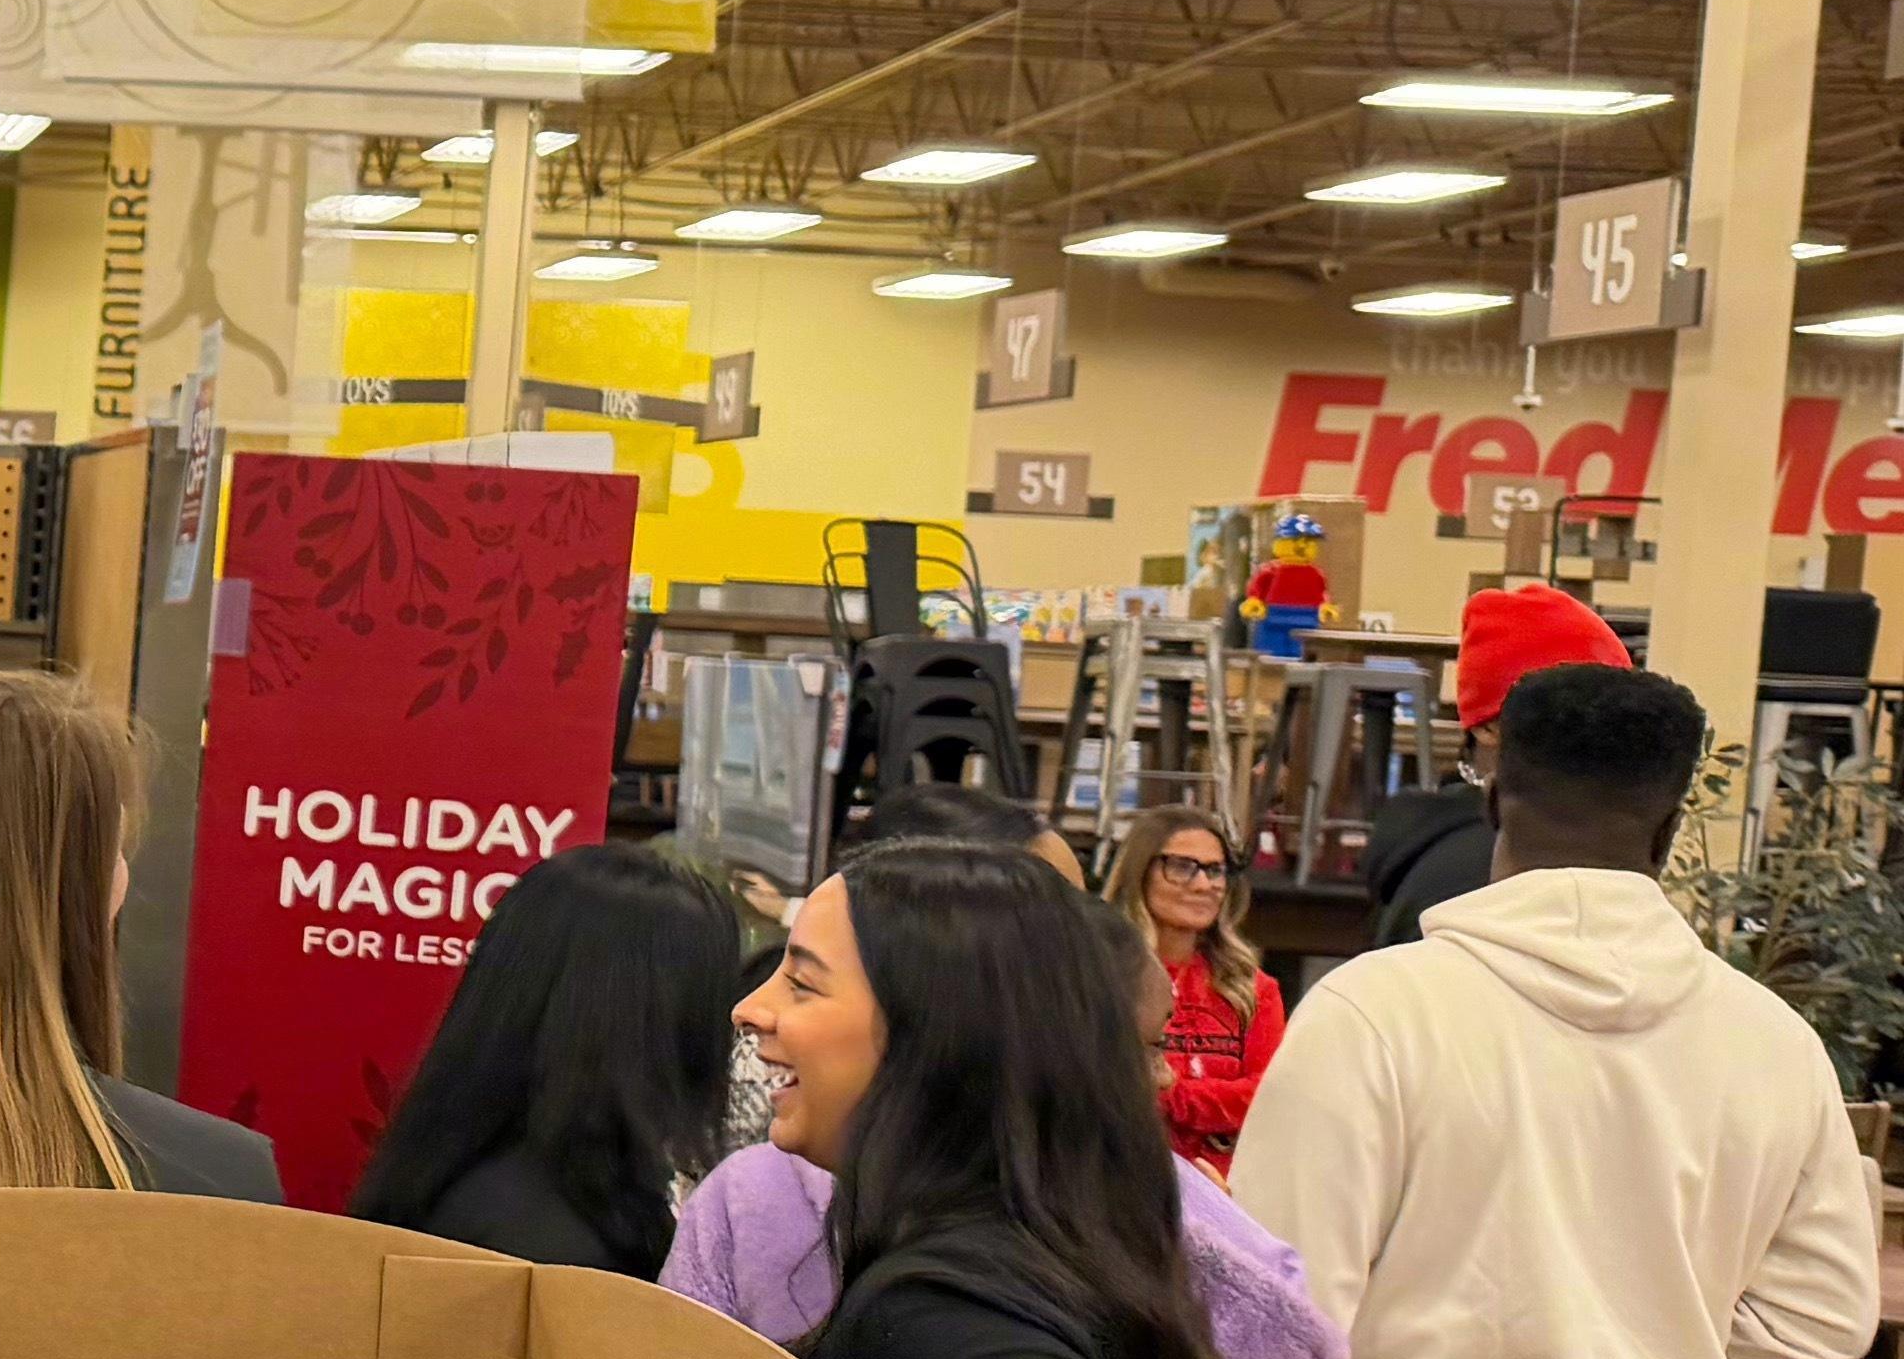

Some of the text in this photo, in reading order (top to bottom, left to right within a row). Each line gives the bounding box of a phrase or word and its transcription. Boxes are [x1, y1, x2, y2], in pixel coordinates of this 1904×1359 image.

[94, 167, 151, 420] FURNITURE
[1580, 213, 1638, 305] 45
[1007, 313, 1040, 382] 47
[600, 388, 640, 419] TOYS
[1258, 372, 1670, 521] Fred
[1019, 461, 1066, 505] 54
[243, 785, 575, 858] HOLIDAY
[279, 856, 519, 922] MAGIC
[302, 925, 383, 959] FOR
